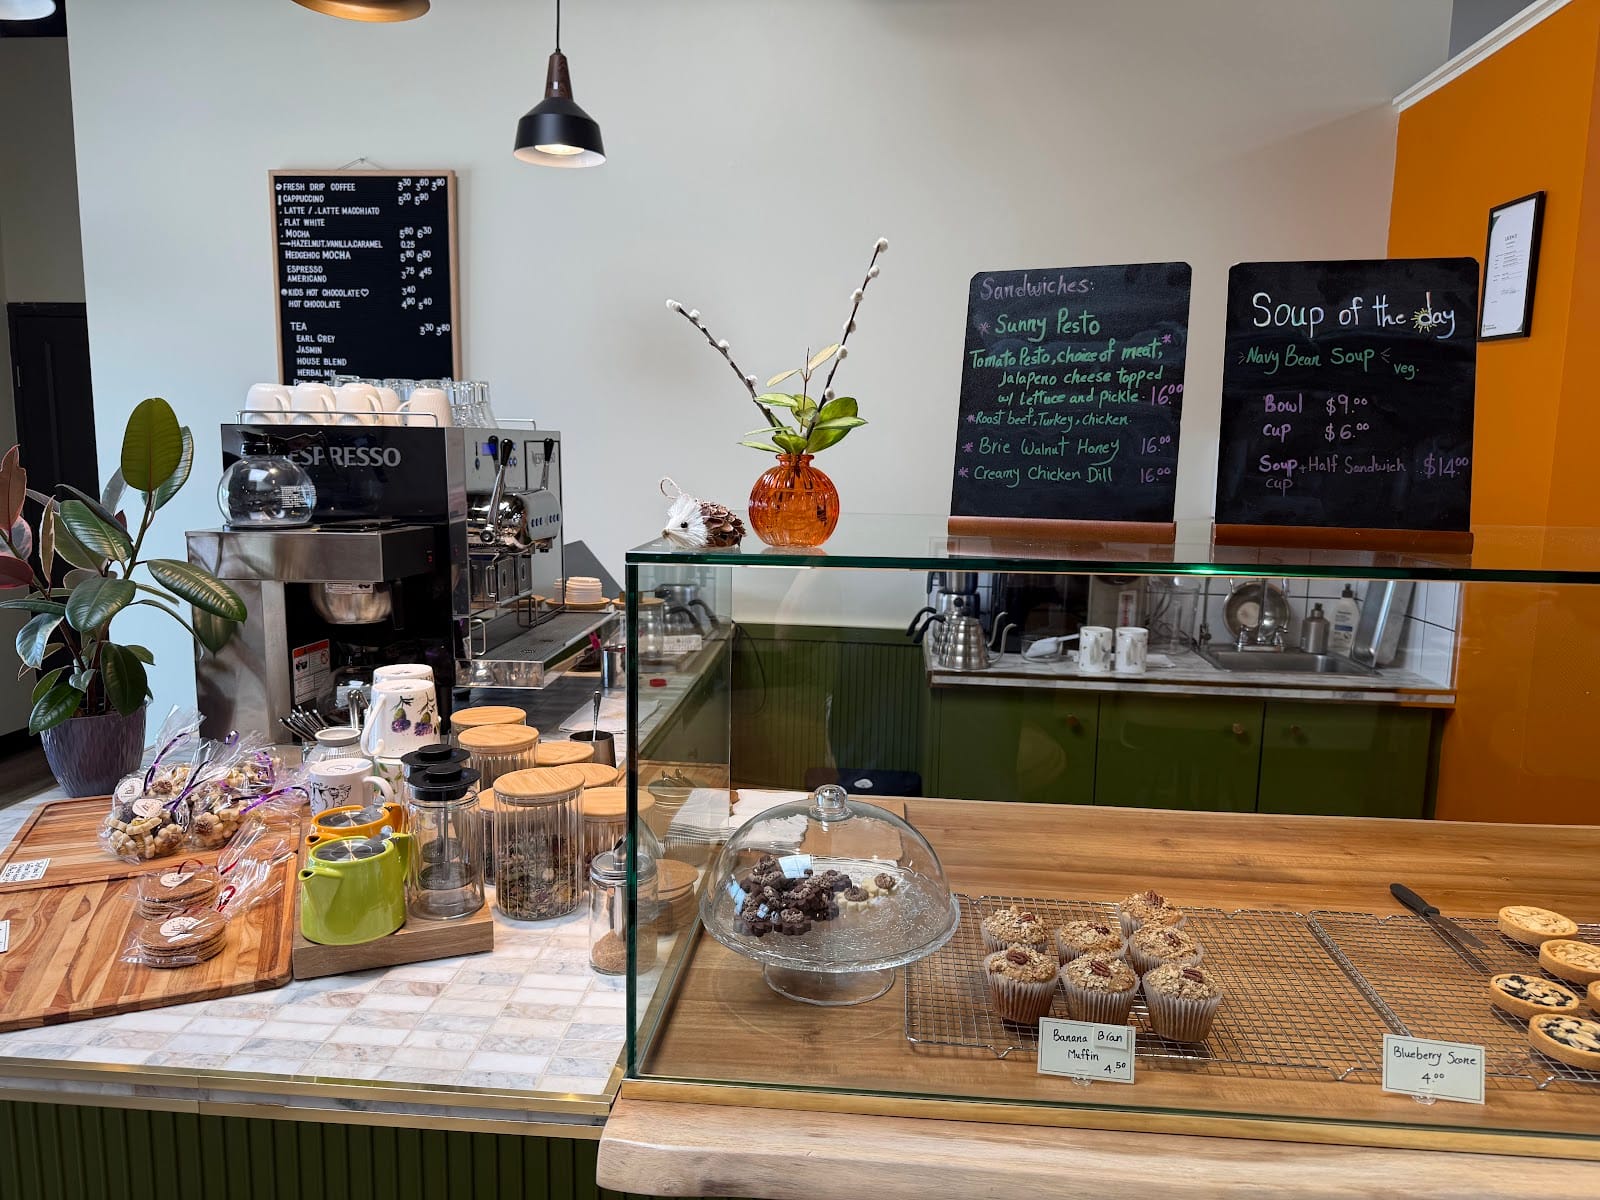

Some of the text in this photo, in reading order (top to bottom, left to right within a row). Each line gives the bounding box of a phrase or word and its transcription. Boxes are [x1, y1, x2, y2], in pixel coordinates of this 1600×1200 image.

[283, 182, 305, 191] FRESH
[309, 182, 326, 191] DRIP
[330, 182, 356, 191] COFFEE
[283, 194, 324, 203] CAPPUCCINO
[284, 206, 305, 215] LATTE
[341, 207, 380, 216] MACCHIATO
[284, 218, 325, 227] FLAT WHITE
[322, 250, 351, 260] MOCHA
[287, 265, 323, 273] ESPRESSO
[287, 275, 327, 283] AMERICANO
[288, 288, 304, 297] KIDS
[306, 288, 319, 297] HOT
[322, 288, 360, 297] CHOCOLATE
[980, 273, 1096, 300] Sandwiches:
[288, 300, 301, 308] HOT
[303, 300, 341, 309] CHOCOLATE
[1252, 291, 1456, 339] Soup of the day
[290, 321, 307, 331] TEA
[995, 307, 1101, 343] Sunny Pesto
[296, 334, 315, 343] EARL
[969, 349, 1016, 369] Tomato
[1099, 338, 1117, 362] of
[1121, 338, 1163, 361] meat,
[1246, 344, 1375, 375] Navy Bean Soup
[296, 357, 347, 366] HOUSE BLEND
[297, 369, 323, 377] HERBAL
[1063, 368, 1112, 384] cheese
[1116, 365, 1164, 389] topped
[1069, 387, 1095, 404] and
[1264, 392, 1303, 414] Bowl
[979, 436, 1011, 455] Brie
[1021, 436, 1070, 457] Walnut
[1077, 438, 1120, 466] Honey
[1344, 455, 1407, 474] Sandwich
[974, 465, 1020, 489] Creamy
[1027, 464, 1081, 482] Chicken
[1086, 466, 1113, 483] Dill
[1053, 1028, 1123, 1043] Banana Bran
[1067, 1048, 1099, 1061] Muffin
[1393, 1045, 1478, 1067] Blueberry Scone
